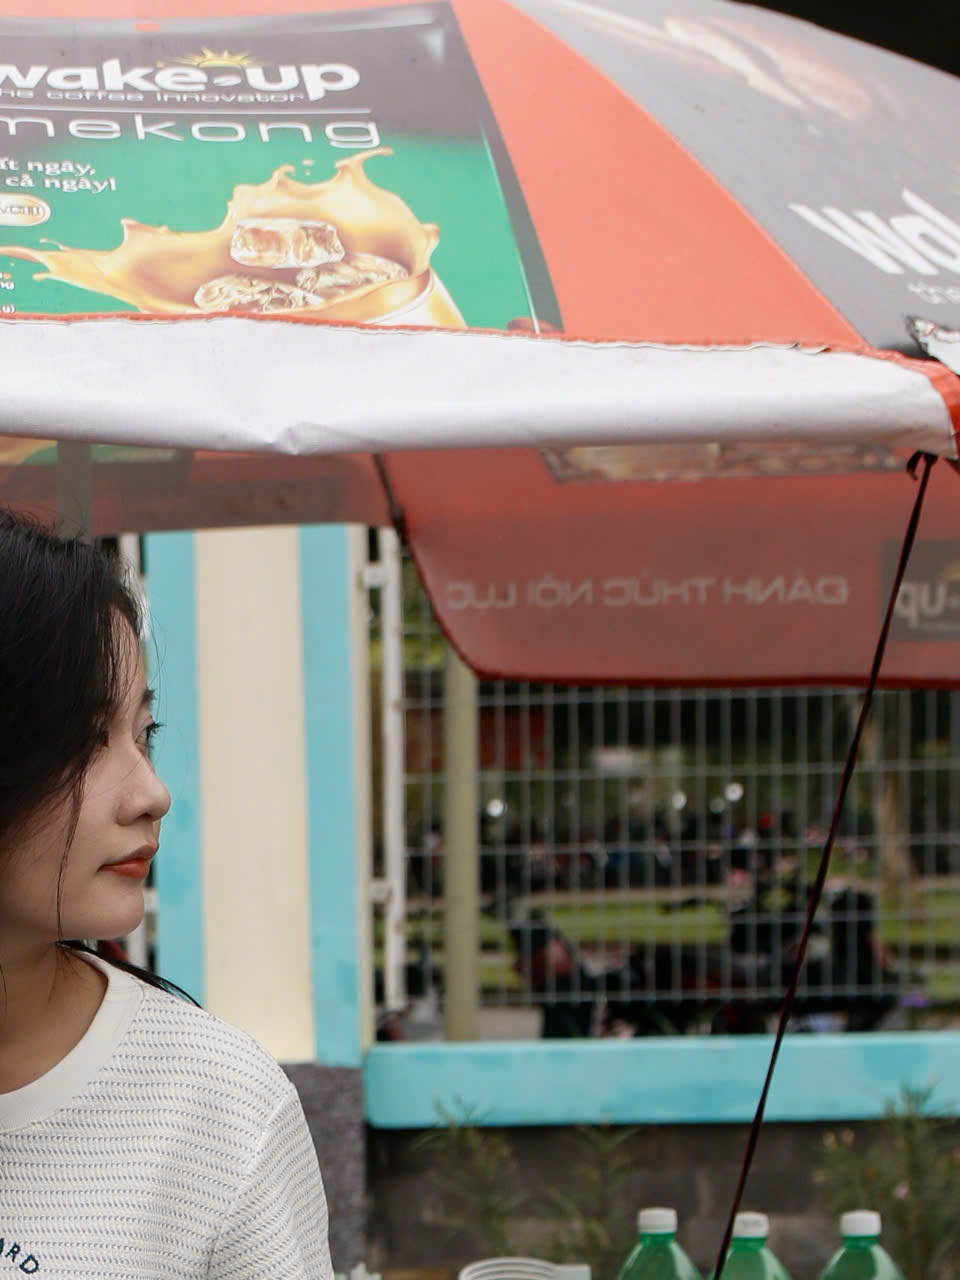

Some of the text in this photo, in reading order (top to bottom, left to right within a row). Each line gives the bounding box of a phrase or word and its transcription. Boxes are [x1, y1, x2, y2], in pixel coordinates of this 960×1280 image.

[156, 91, 304, 103] innovator
[27, 159, 95, 176] ngây,
[5, 174, 35, 187] cả
[44, 177, 116, 193] ngày!
